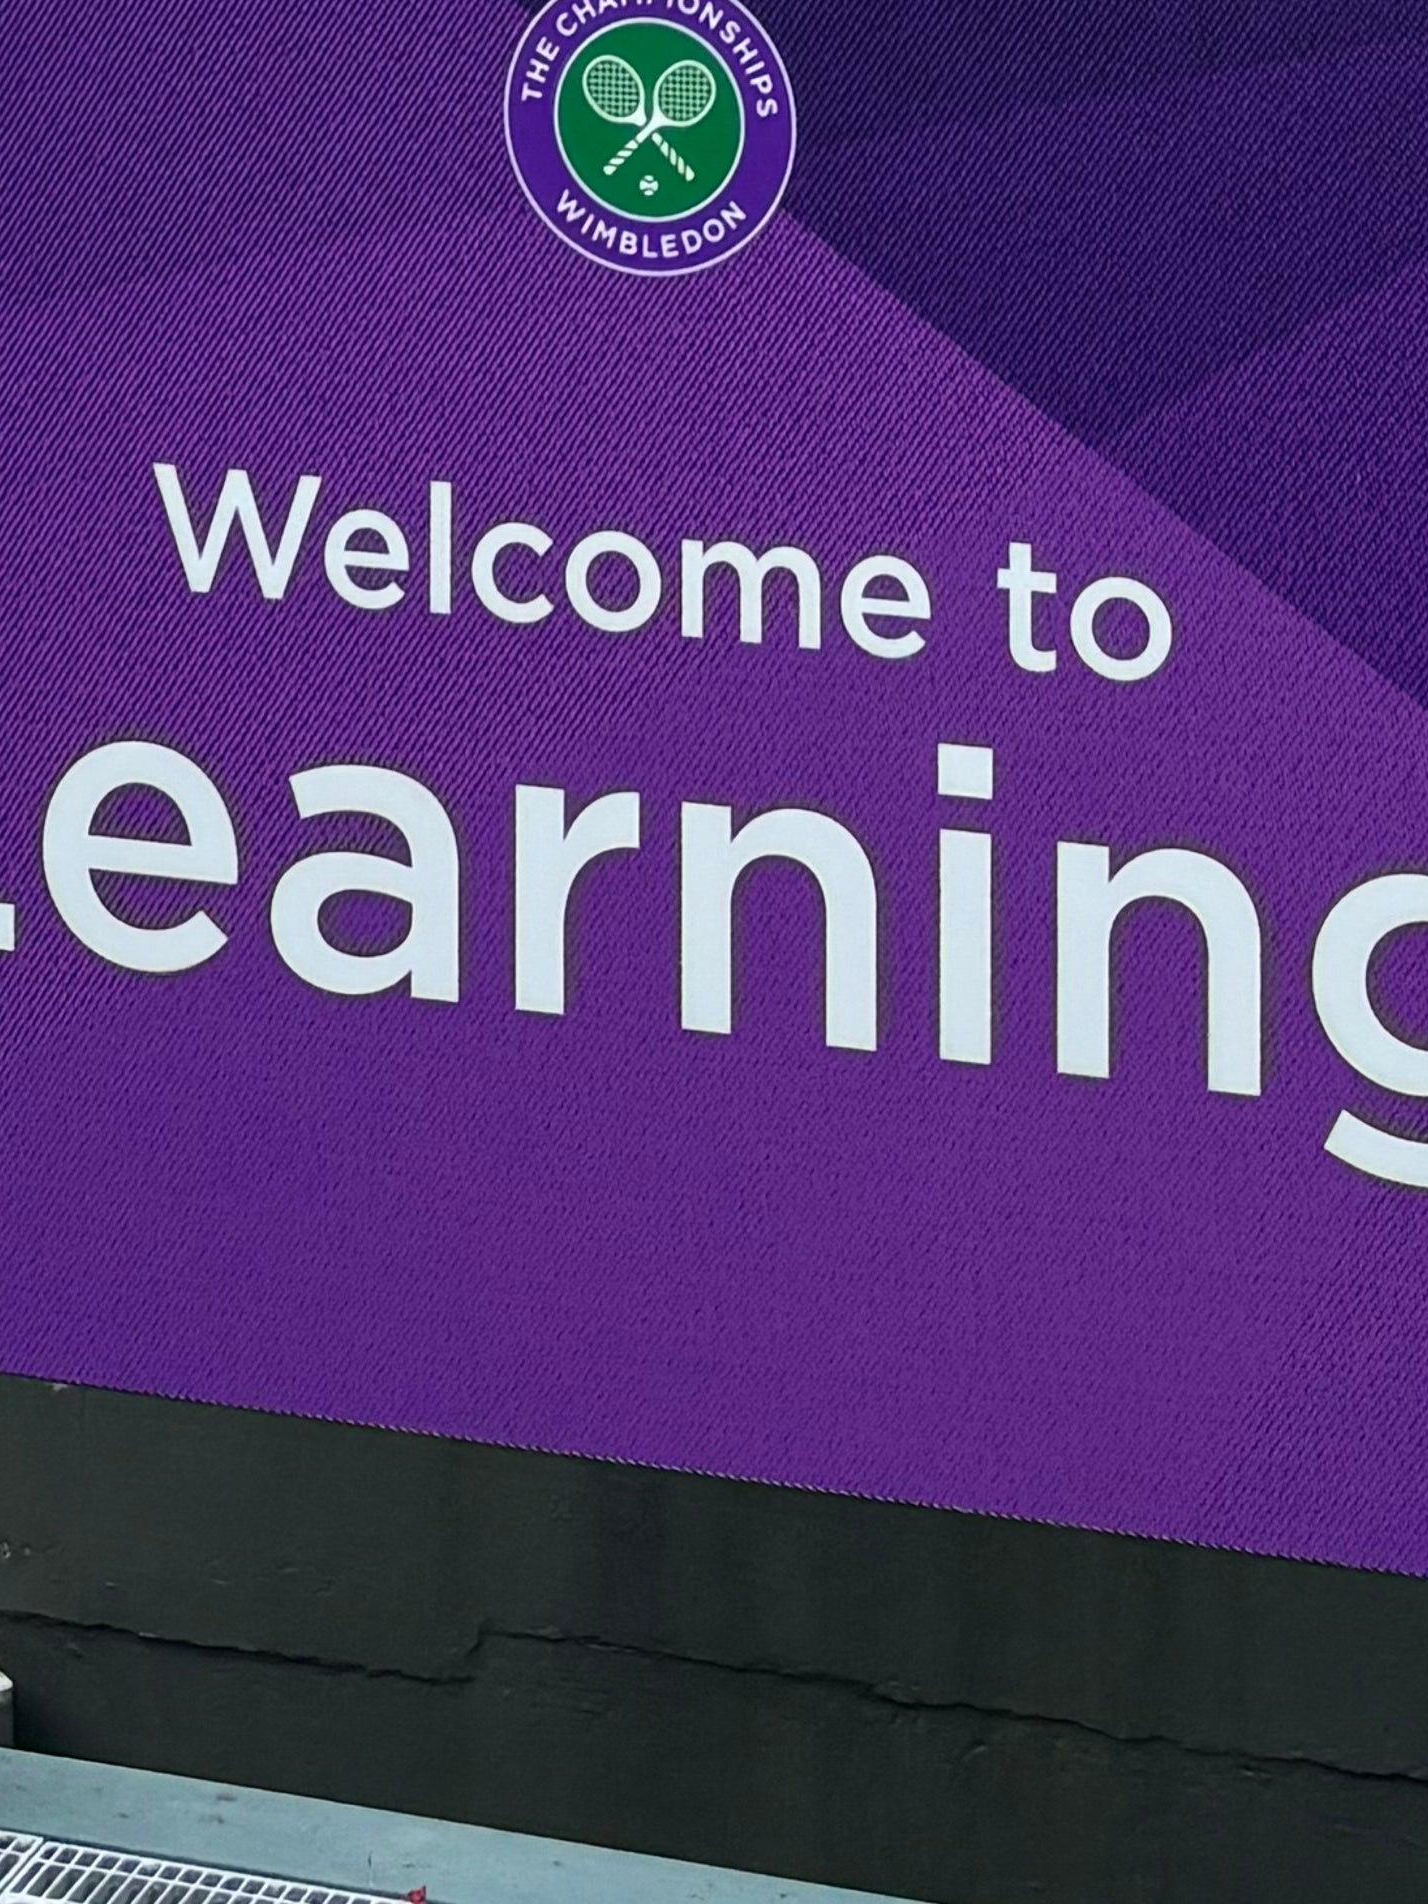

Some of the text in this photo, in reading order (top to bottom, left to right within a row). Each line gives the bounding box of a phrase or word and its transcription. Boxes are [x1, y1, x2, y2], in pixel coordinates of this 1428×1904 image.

[521, 36, 560, 102] THE
[556, 188, 747, 259] WIMBLEDON
[154, 463, 1171, 682] Welcome to
